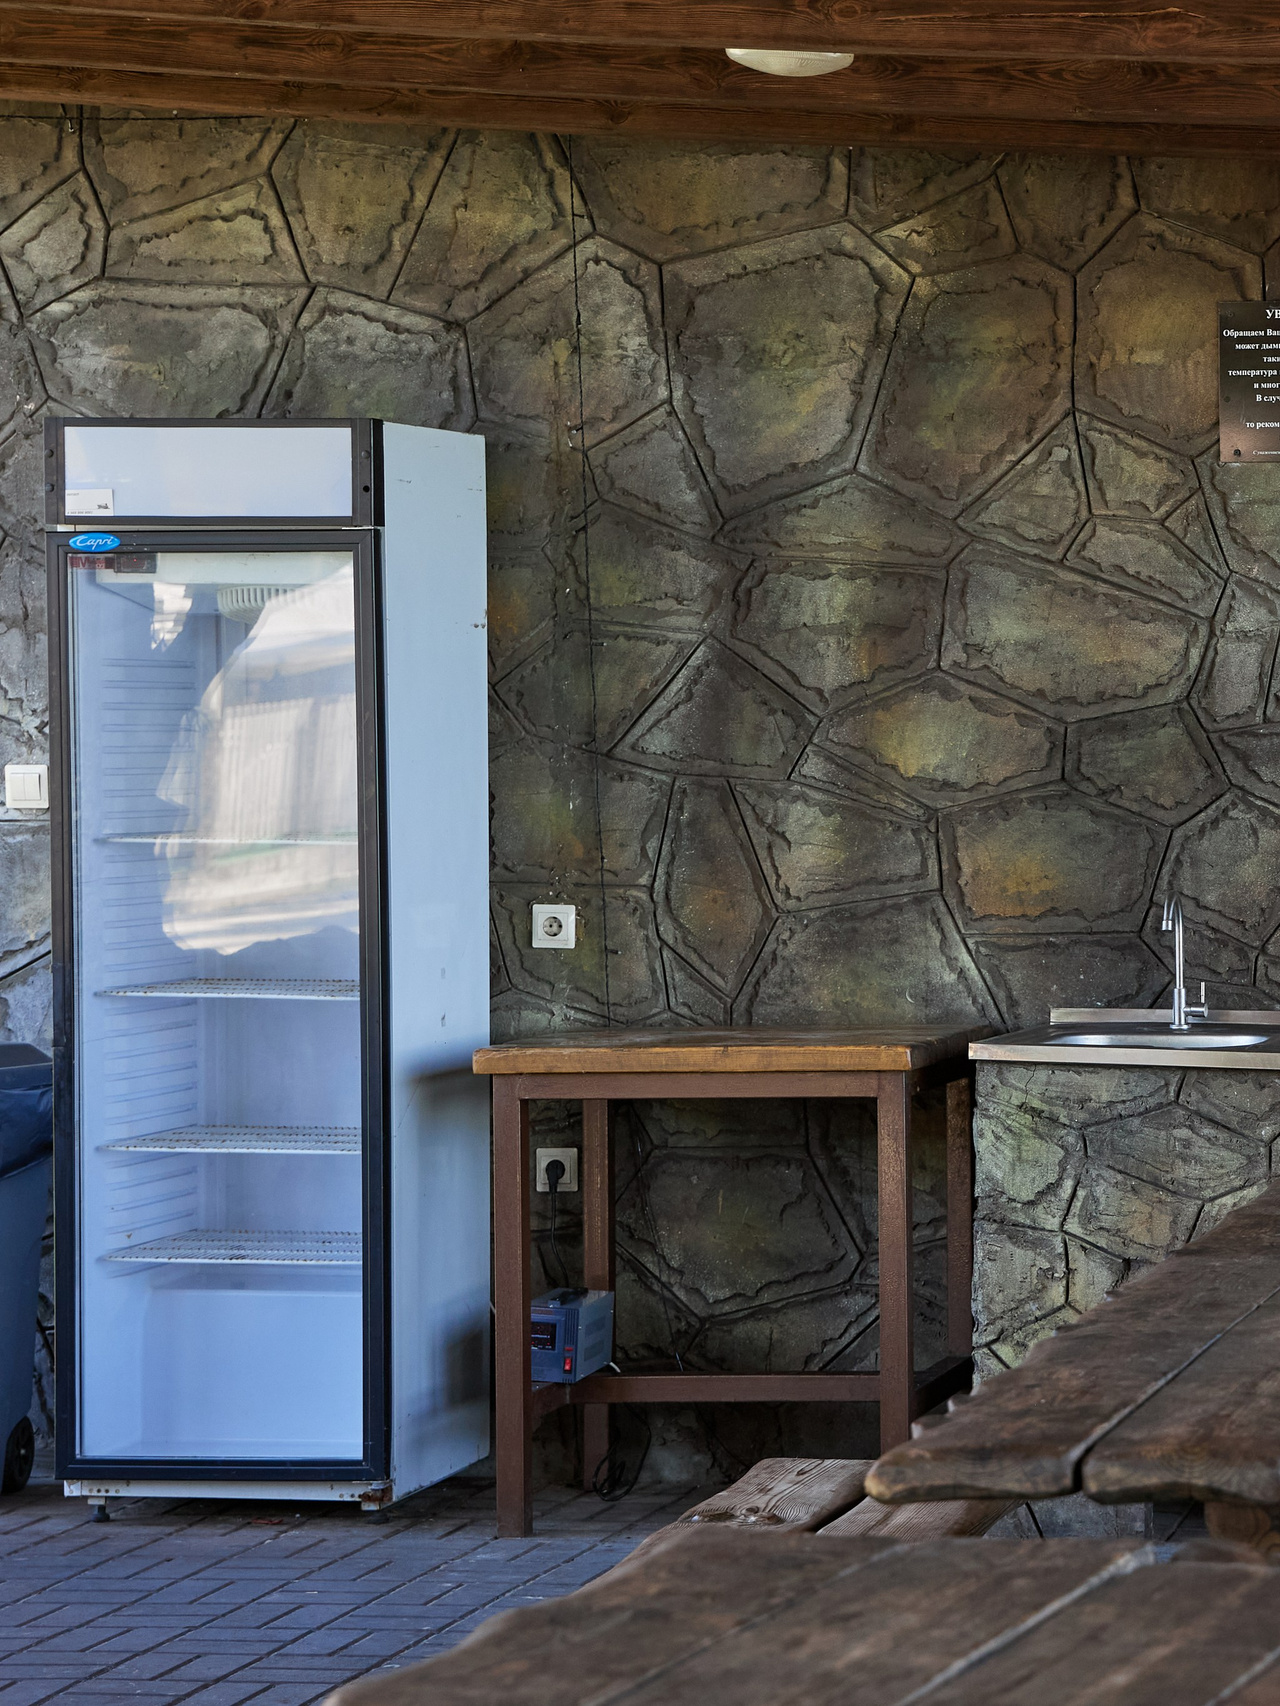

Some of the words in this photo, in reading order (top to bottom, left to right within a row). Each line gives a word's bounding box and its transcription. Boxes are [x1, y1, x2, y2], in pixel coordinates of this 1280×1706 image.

[1222, 328, 1265, 339] Обращаем
[1227, 369, 1278, 378] температура
[75, 535, 114, 550] Capri
